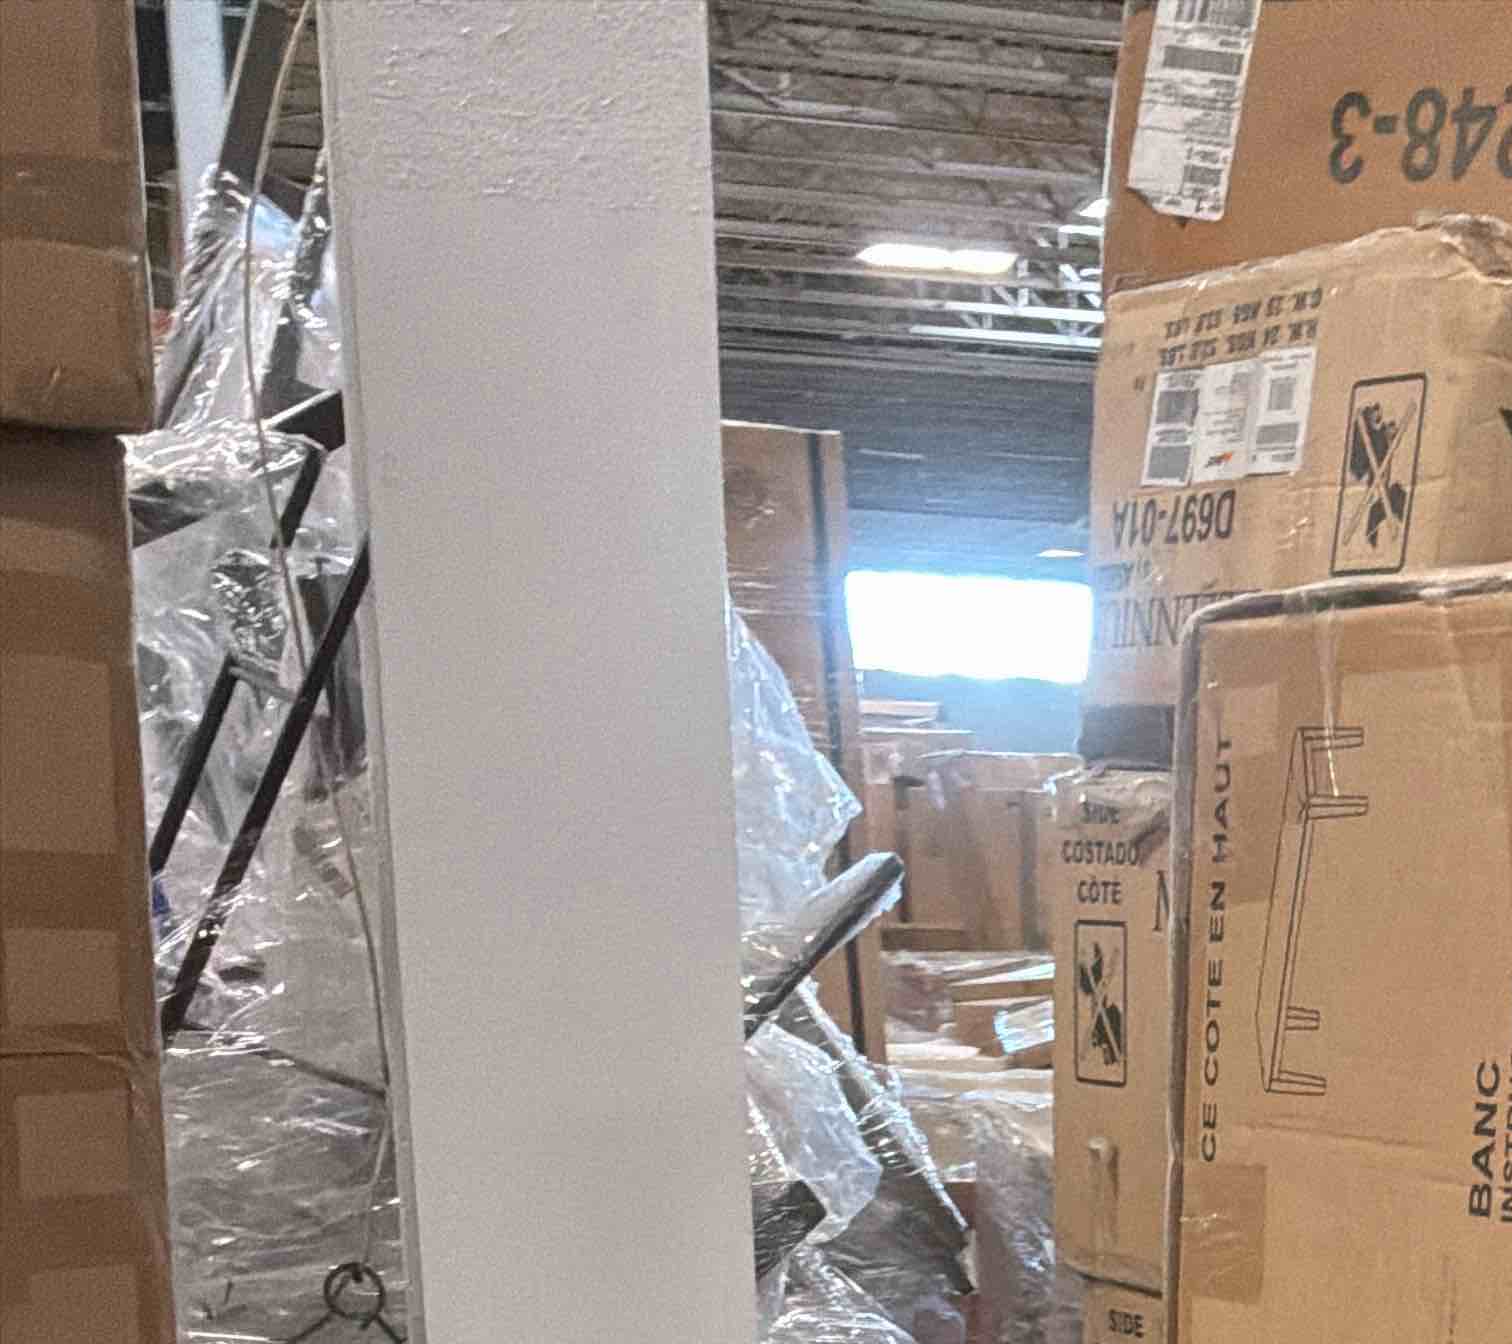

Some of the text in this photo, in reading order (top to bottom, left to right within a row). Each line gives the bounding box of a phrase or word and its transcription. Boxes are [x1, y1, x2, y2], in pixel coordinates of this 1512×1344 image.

[1112, 489, 1237, 548] D697-01A
[1061, 840, 1138, 866] COSTADO
[1201, 730, 1233, 1163] CE COTE EN HAUT
[1468, 1060, 1501, 1218] BANC
[1109, 1308, 1144, 1338] SIDE
